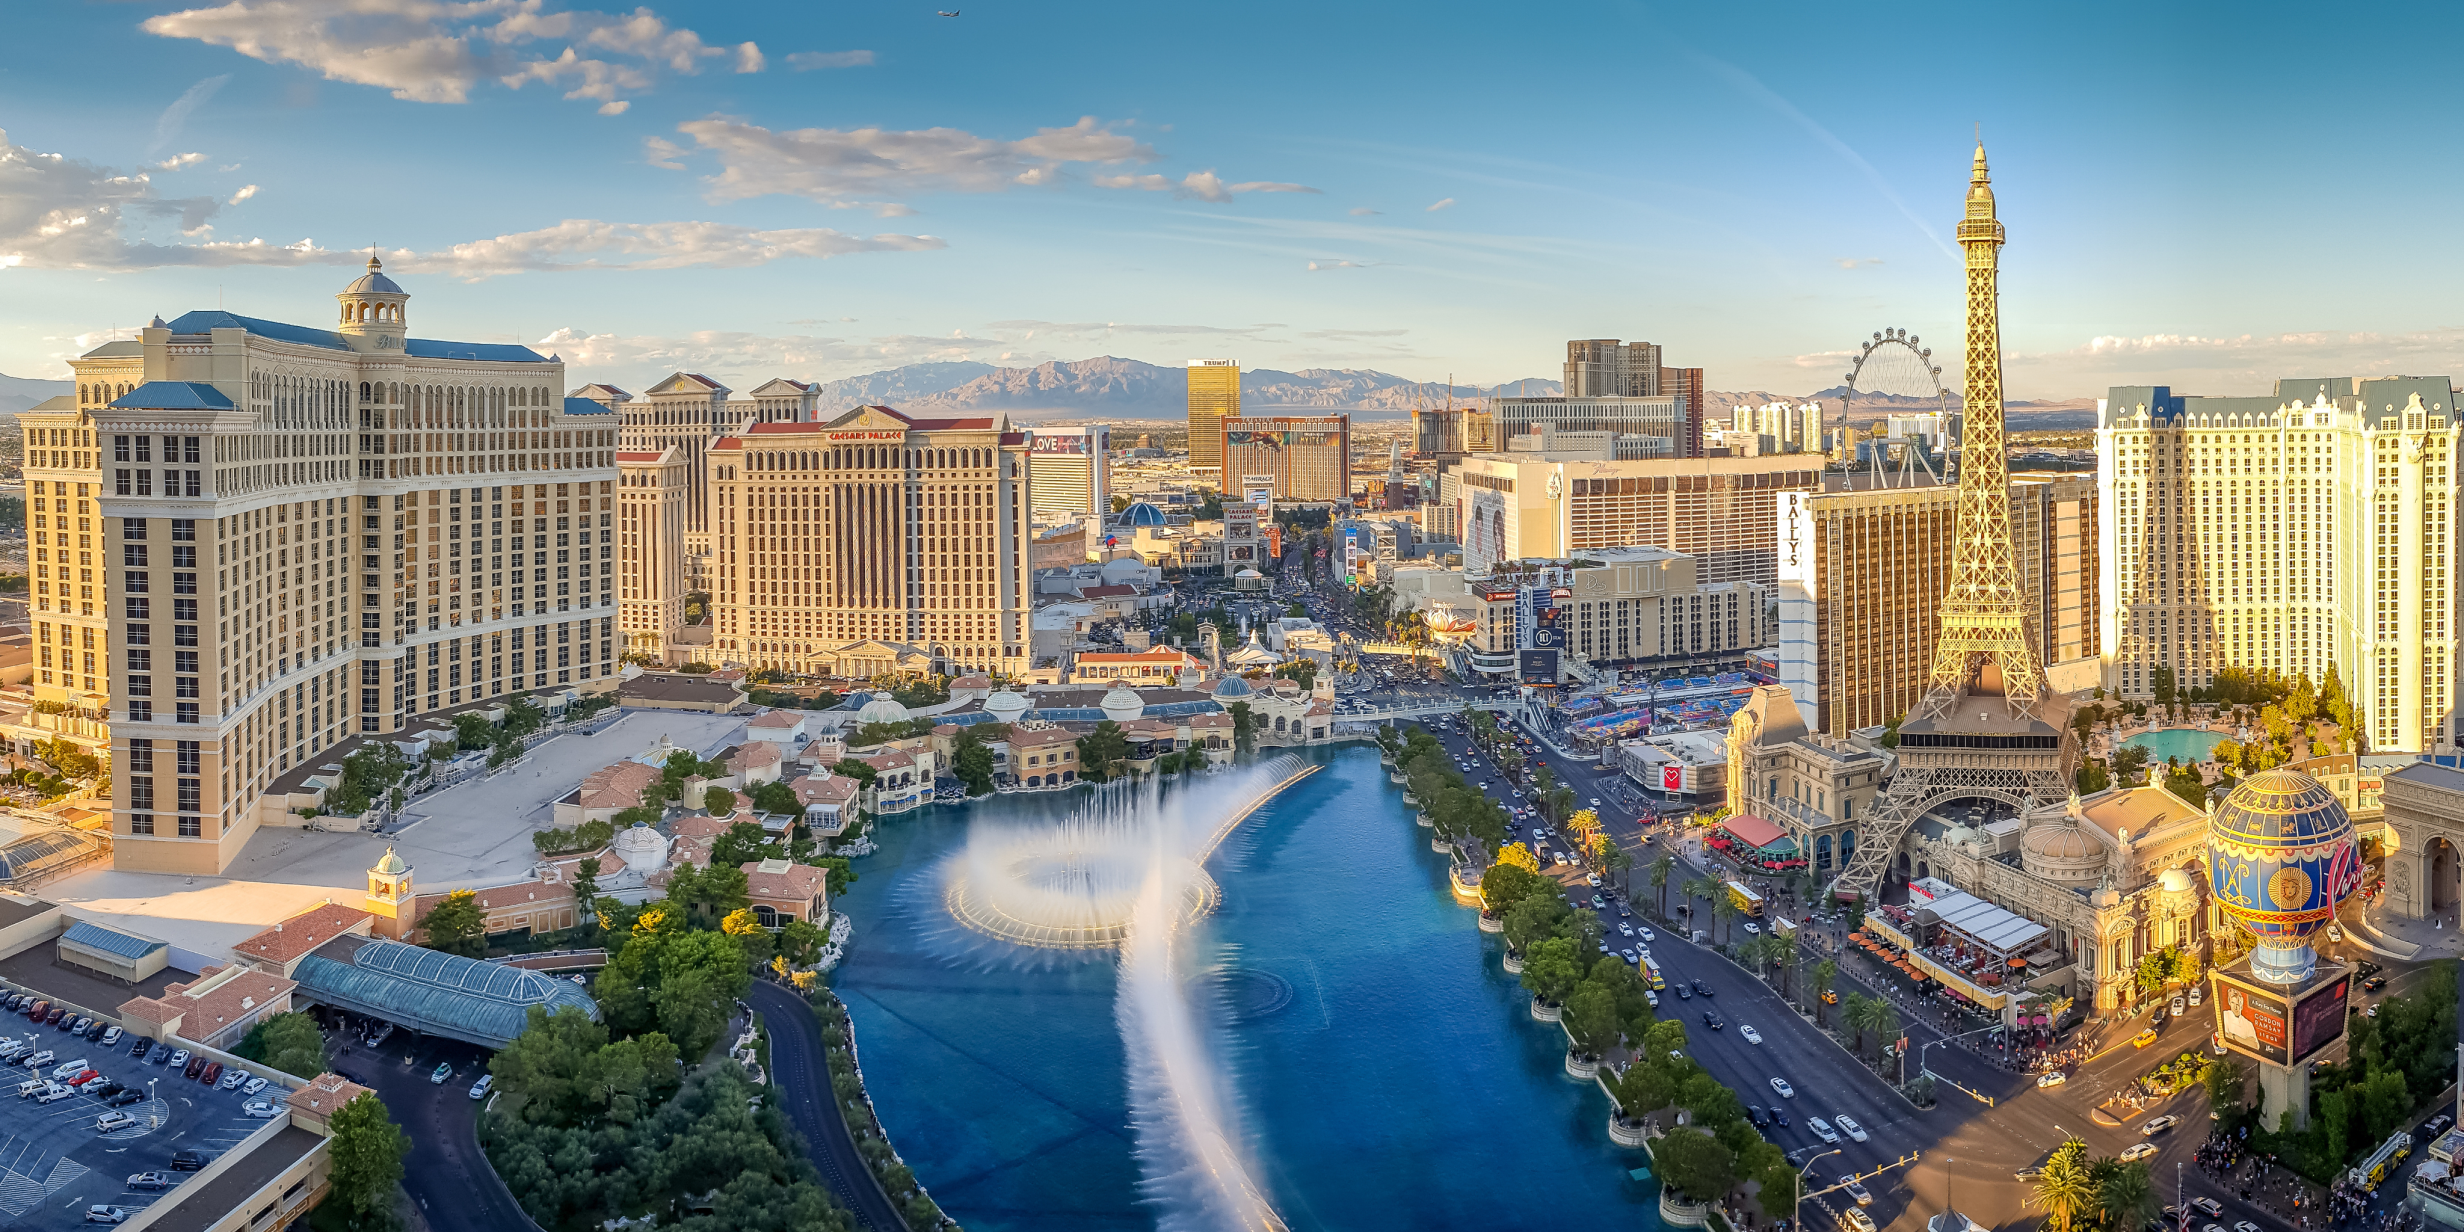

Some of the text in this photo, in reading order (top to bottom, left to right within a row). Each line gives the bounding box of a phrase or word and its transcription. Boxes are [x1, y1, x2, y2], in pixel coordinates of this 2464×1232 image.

[829, 431, 902, 440] CAESARS PALACE
[1521, 591, 1529, 643] BALLYS
[2327, 842, 2367, 920] Paris
[2254, 1013, 2282, 1028] GORDON
[2254, 1019, 2282, 1034] RAMSAY
